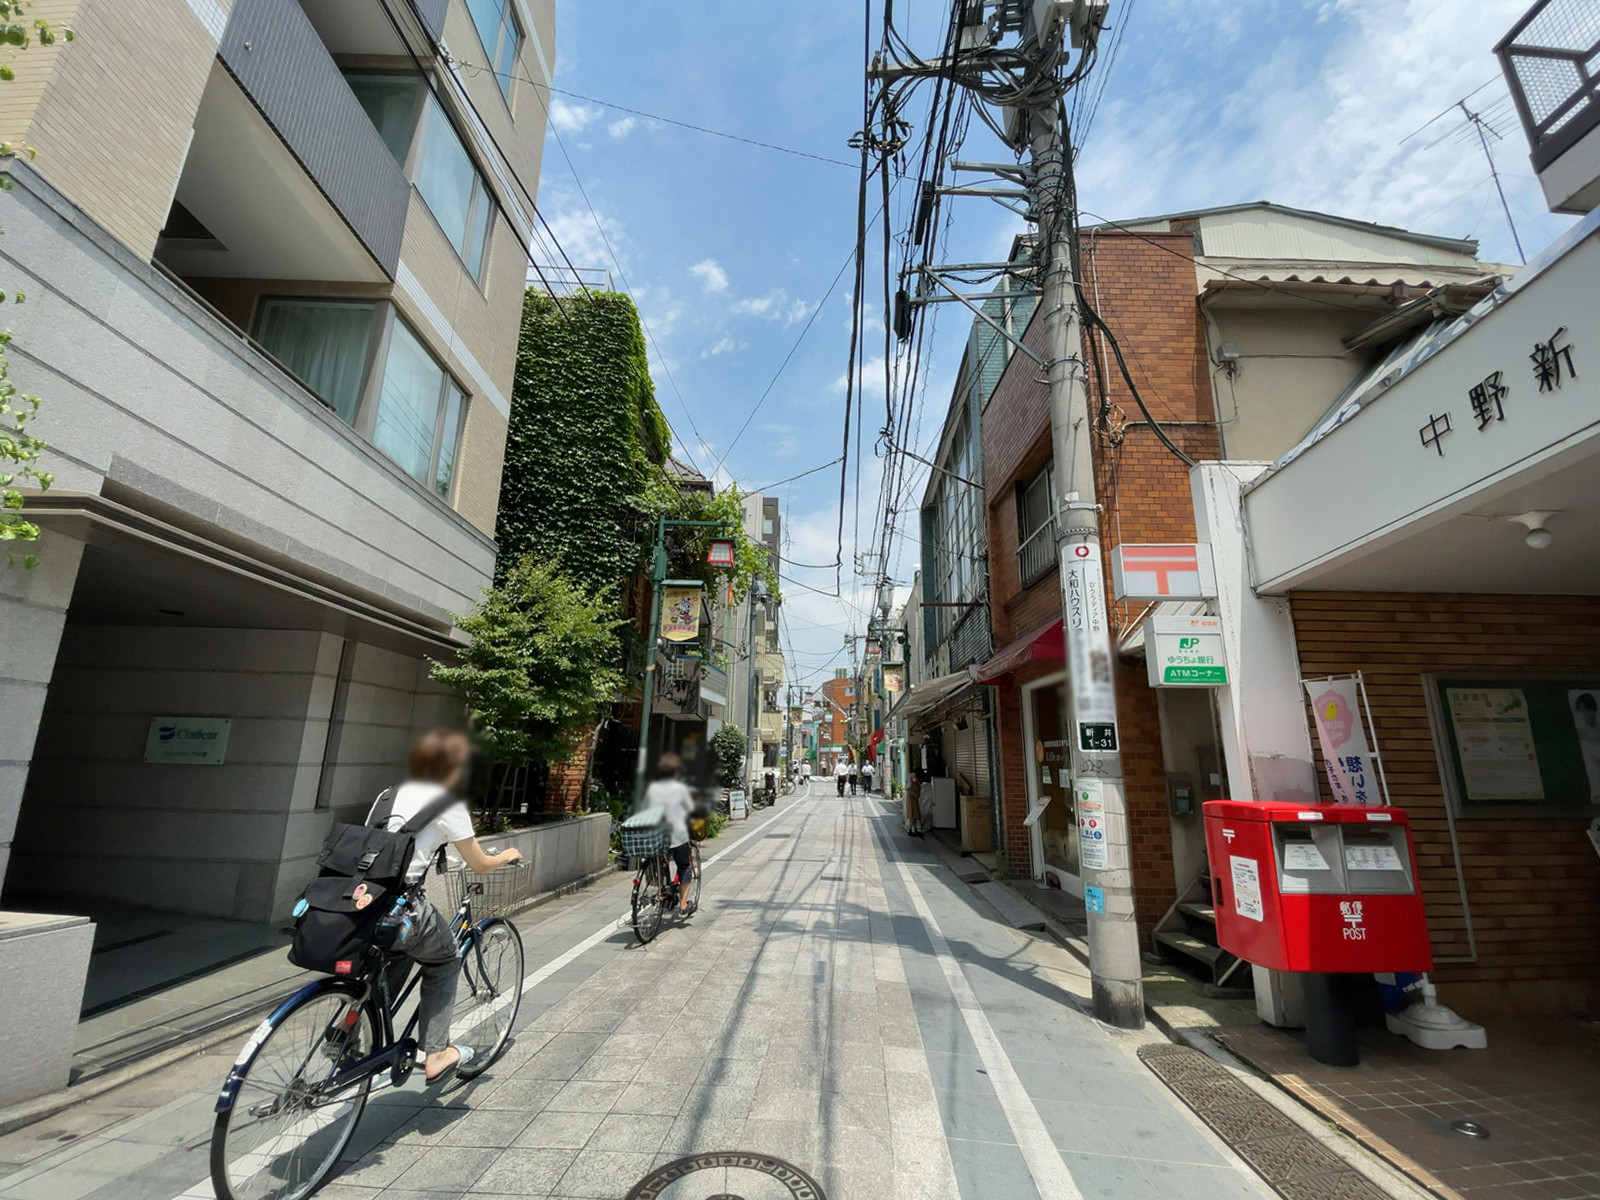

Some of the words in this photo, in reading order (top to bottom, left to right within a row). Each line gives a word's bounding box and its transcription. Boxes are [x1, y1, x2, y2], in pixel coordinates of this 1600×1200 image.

[1419, 326, 1577, 456] 中野新
[1068, 569, 1083, 631] 大和ハウスリ
[1179, 638, 1200, 649] JP
[1167, 655, 1214, 664] ゆうちょ銀行
[1170, 669, 1221, 677] ATMコーナー
[1085, 728, 1112, 737] 新井
[1088, 738, 1112, 748] 1-31
[1342, 927, 1367, 941] POST
